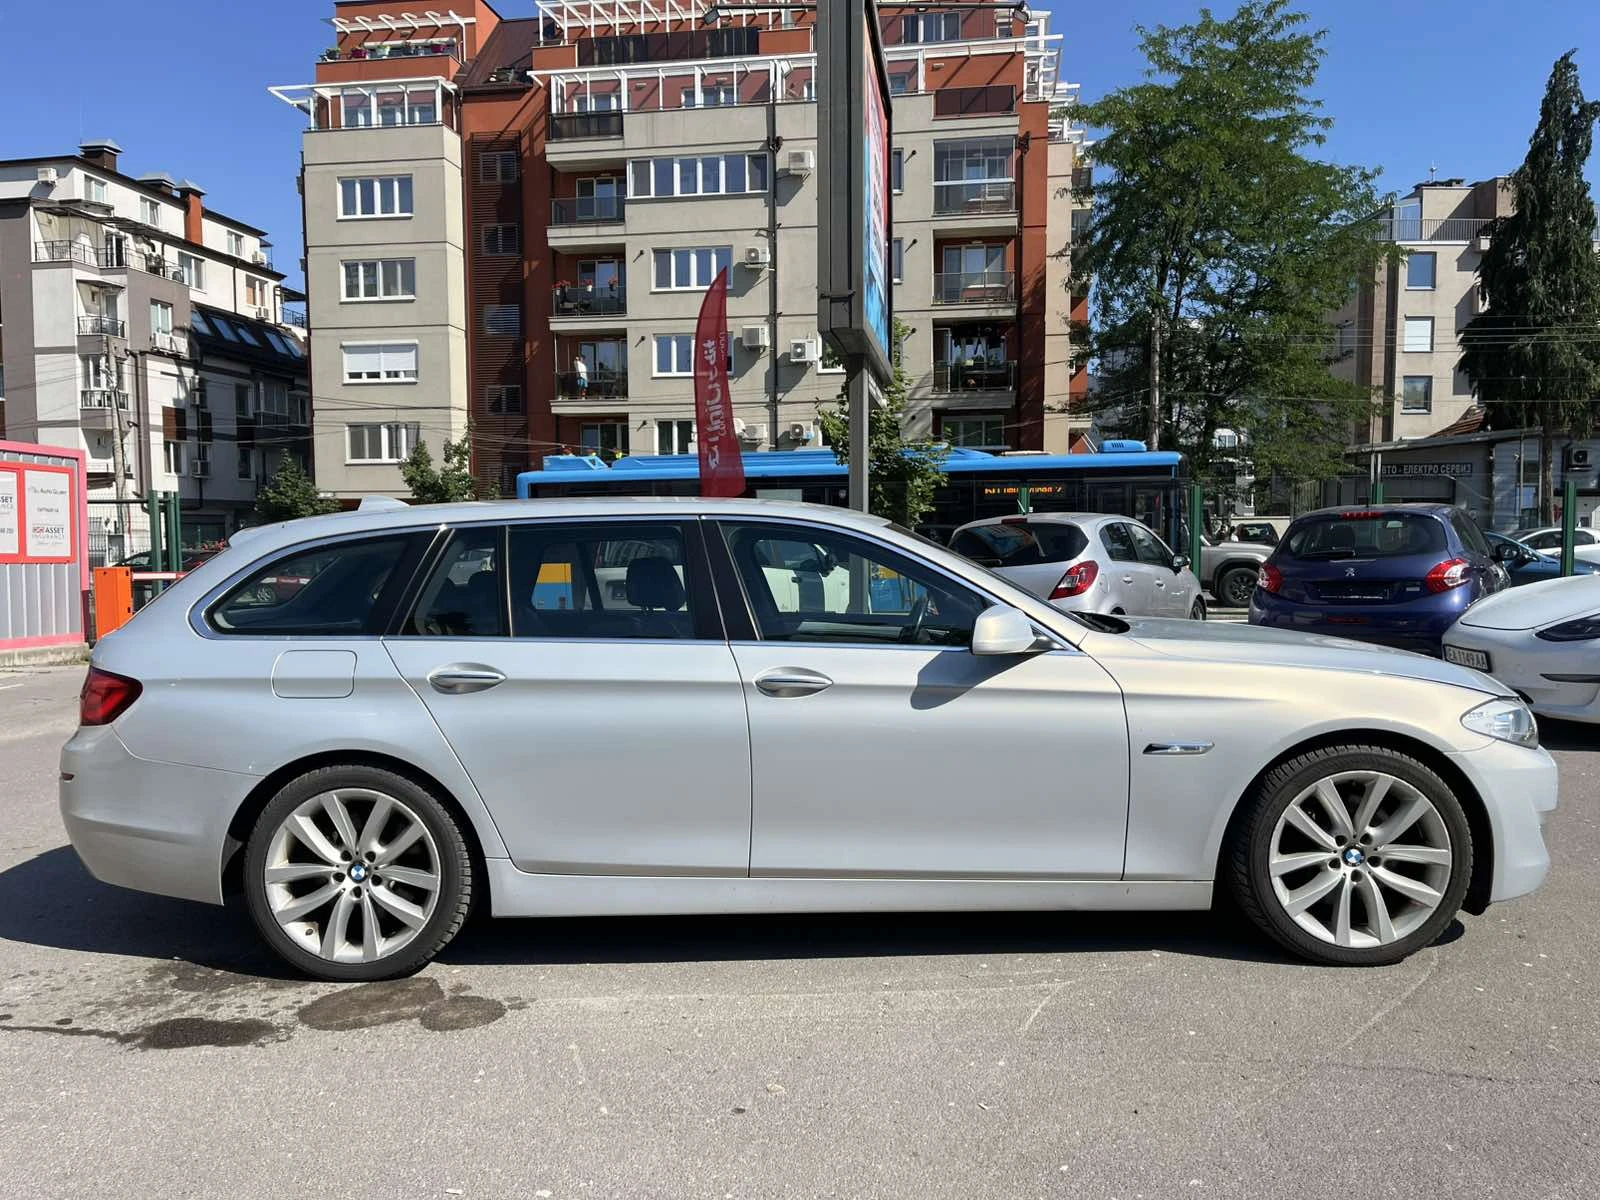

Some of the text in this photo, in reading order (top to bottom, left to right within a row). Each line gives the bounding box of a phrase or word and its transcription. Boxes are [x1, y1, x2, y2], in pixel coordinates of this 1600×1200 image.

[1381, 464, 1397, 474] ВТО
[1403, 464, 1438, 474] ЕЛЕКТРО
[1440, 464, 1472, 474] СЕРВИЗ
[45, 526, 64, 534] ASSET
